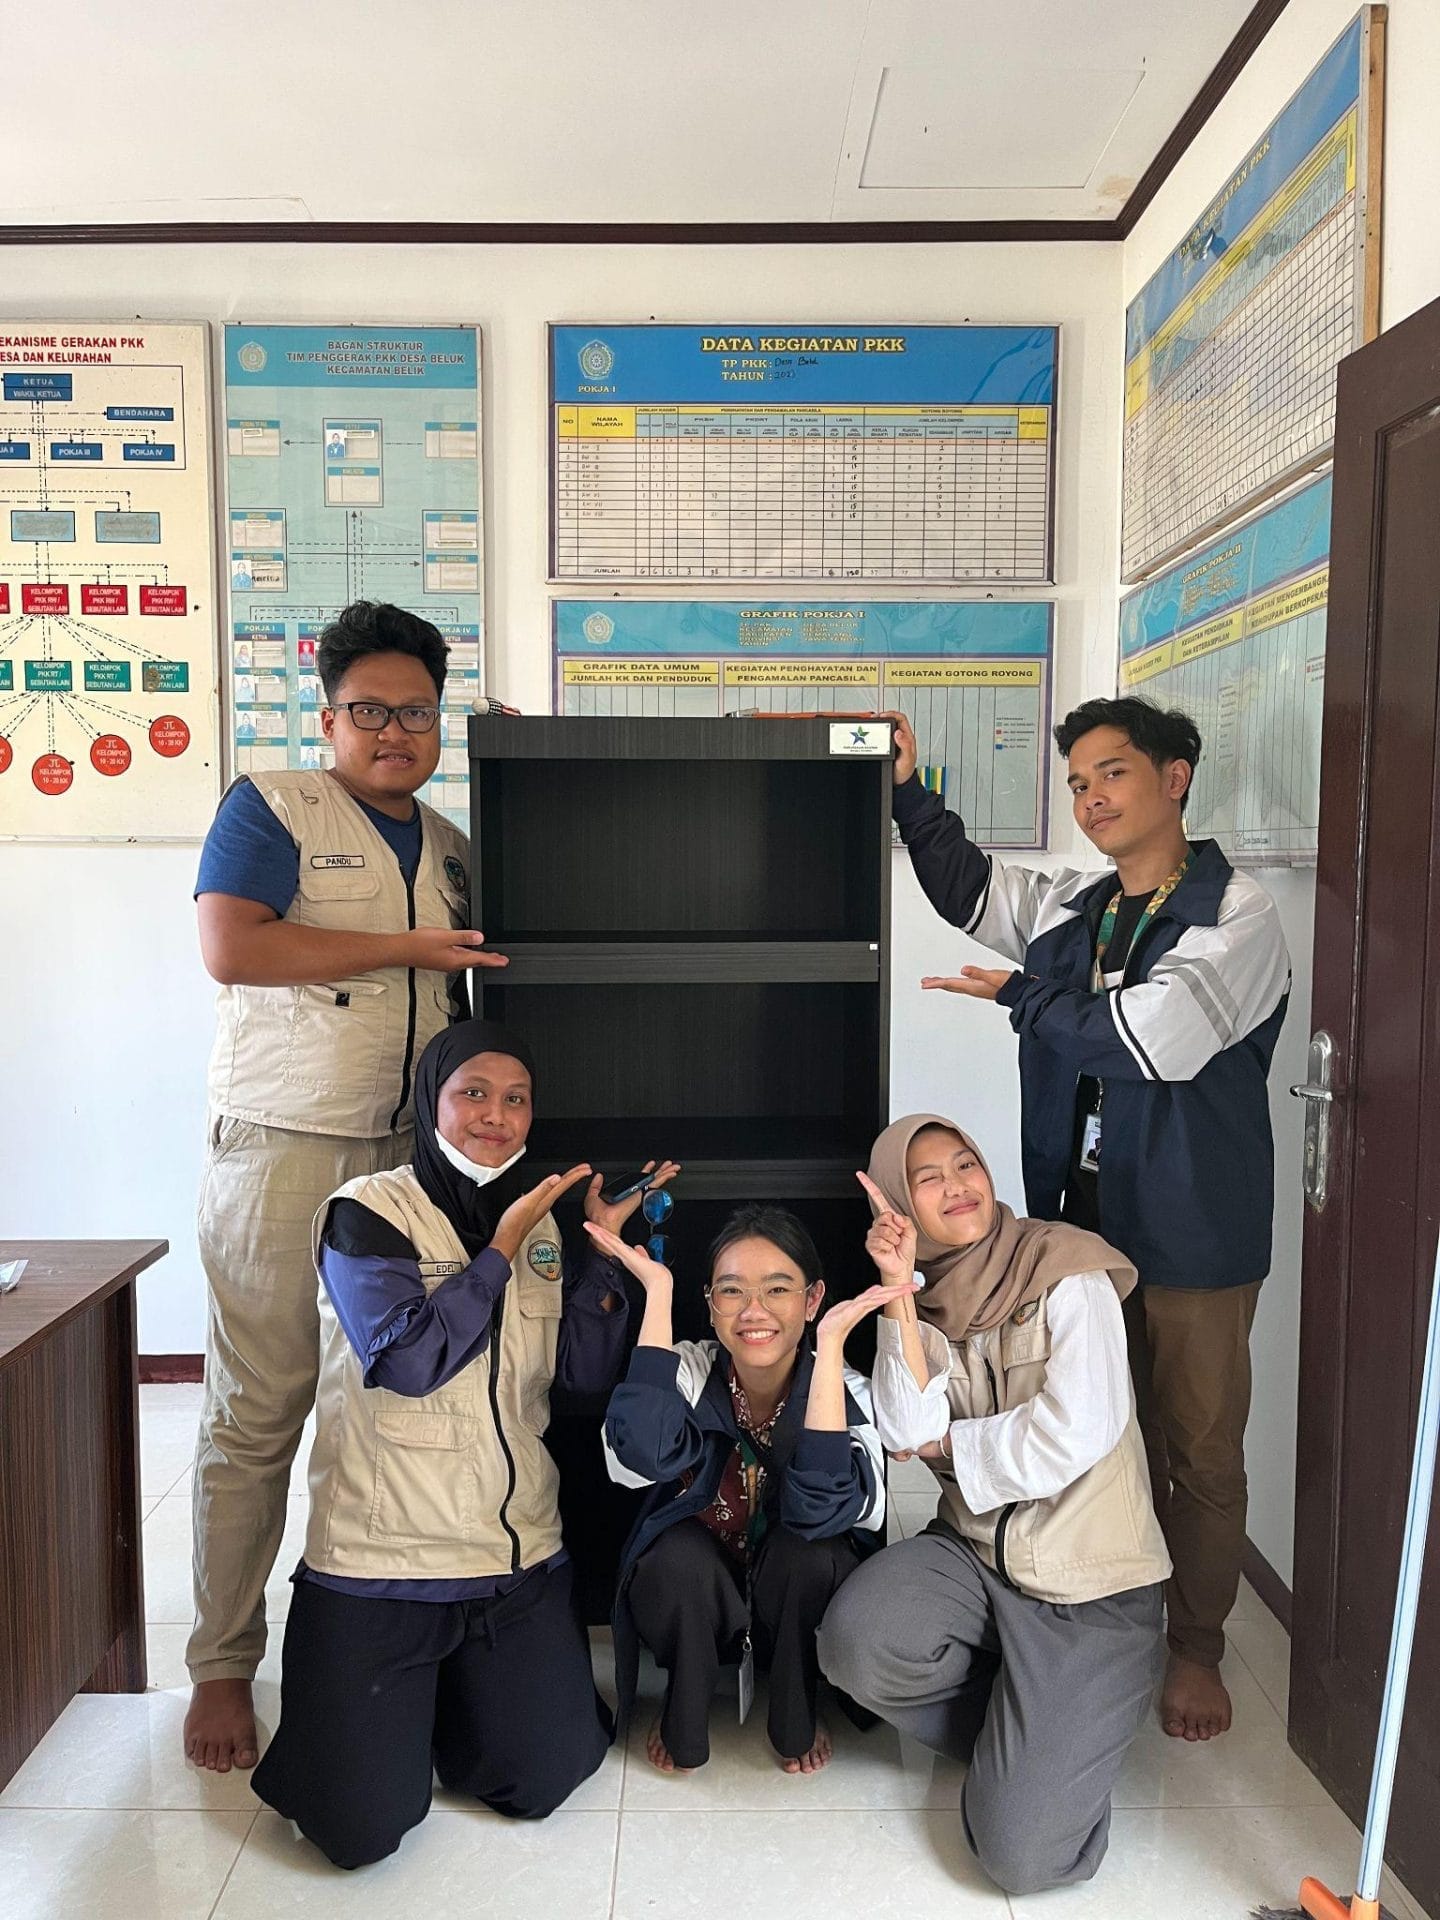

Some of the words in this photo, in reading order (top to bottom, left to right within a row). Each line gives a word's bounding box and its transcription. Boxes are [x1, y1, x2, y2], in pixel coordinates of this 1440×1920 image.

[0, 337, 57, 347] EKANISME
[62, 337, 116, 348] GERAKAN
[121, 338, 144, 348] PKK
[367, 342, 423, 350] STRUKTUR
[702, 338, 754, 351] DATA
[760, 338, 858, 351] KEGIATAN
[864, 338, 904, 351] PKK
[0, 352, 19, 362] ESA
[23, 352, 44, 362] DAN
[48, 353, 111, 363] KELURAHAN
[287, 353, 304, 361] TIM
[308, 353, 371, 362] PENGGERAK
[376, 354, 396, 362] PKK
[400, 354, 427, 362] DESA
[430, 354, 464, 363] BELUK
[327, 366, 390, 374] KECAMATAN
[394, 366, 424, 375] BELIK
[722, 372, 764, 380] TAHUN
[436, 1264, 455, 1273] EDEL
